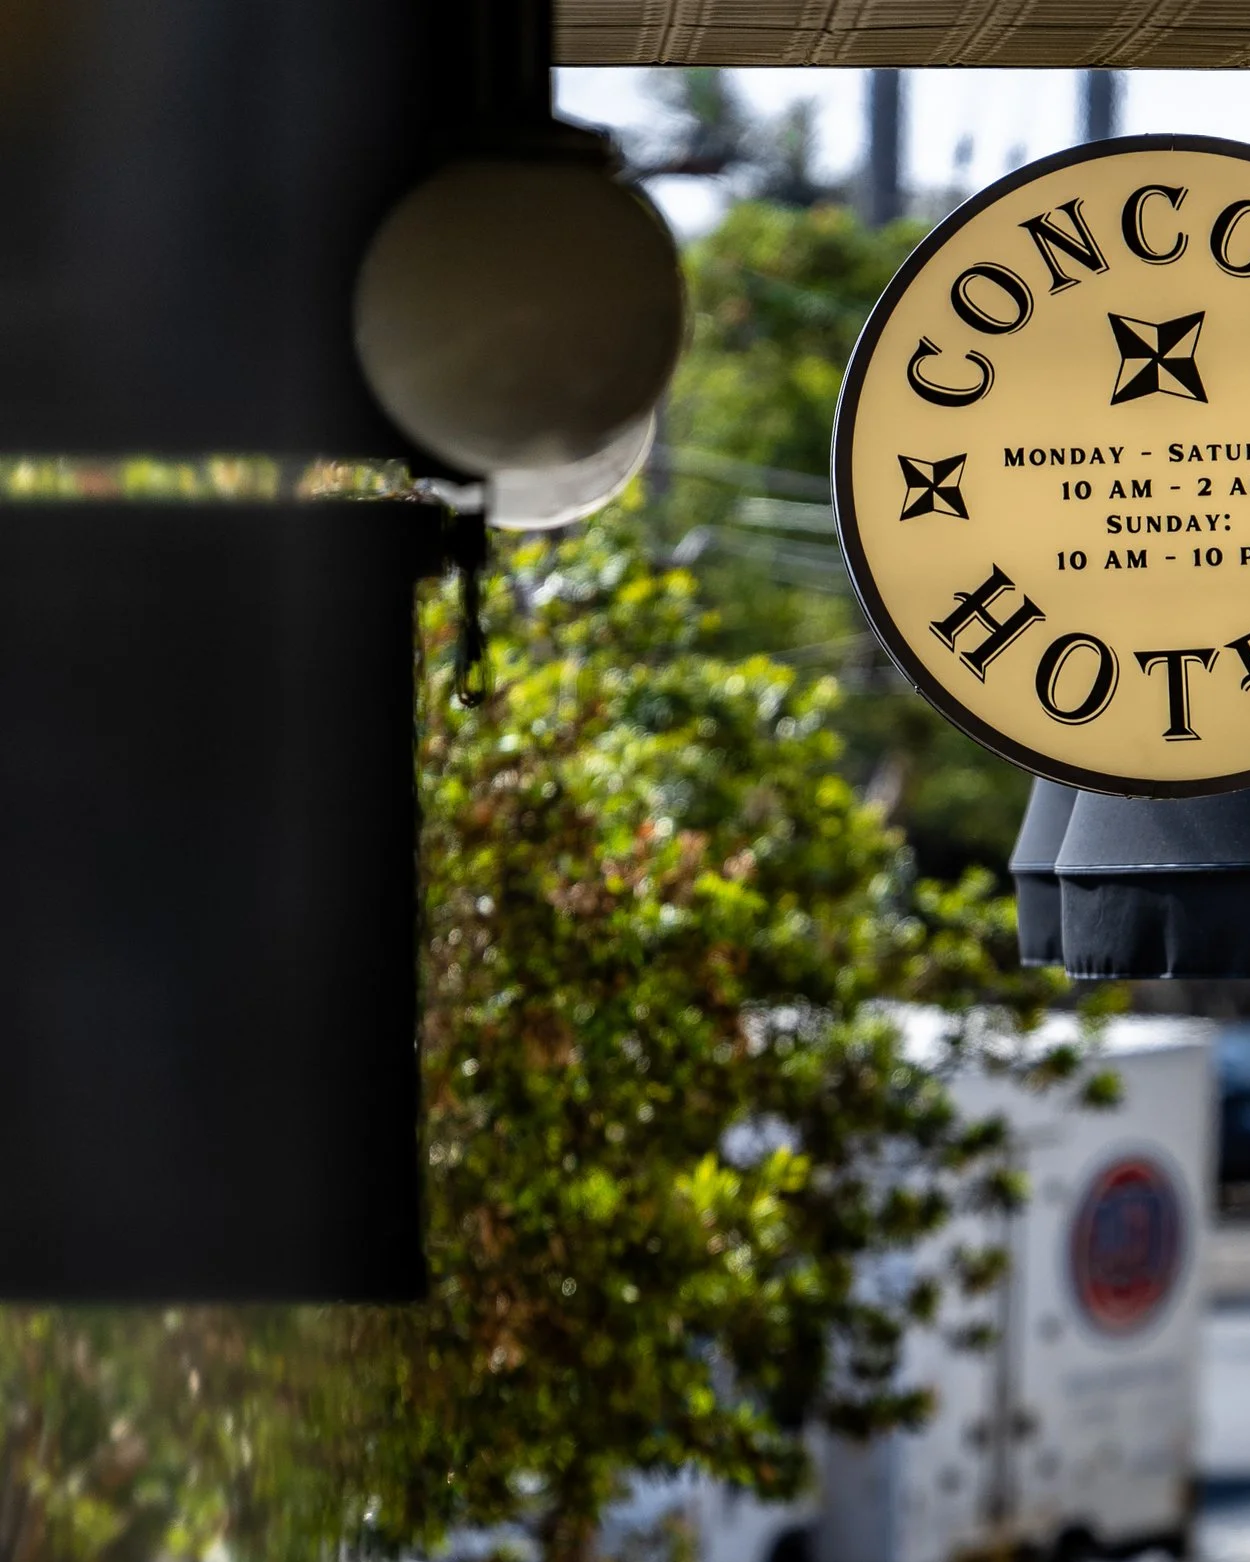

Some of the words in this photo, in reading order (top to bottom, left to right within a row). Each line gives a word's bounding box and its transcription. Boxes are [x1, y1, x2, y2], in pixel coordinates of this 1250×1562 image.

[1003, 446, 1125, 467] MONDAY
[1062, 480, 1092, 501] 10
[1108, 479, 1153, 499] AM
[1197, 477, 1212, 497] 2
[1106, 513, 1231, 534] SUNDAY:
[1057, 550, 1088, 571] 10
[1104, 549, 1148, 570] AM
[1193, 547, 1223, 567] 10
